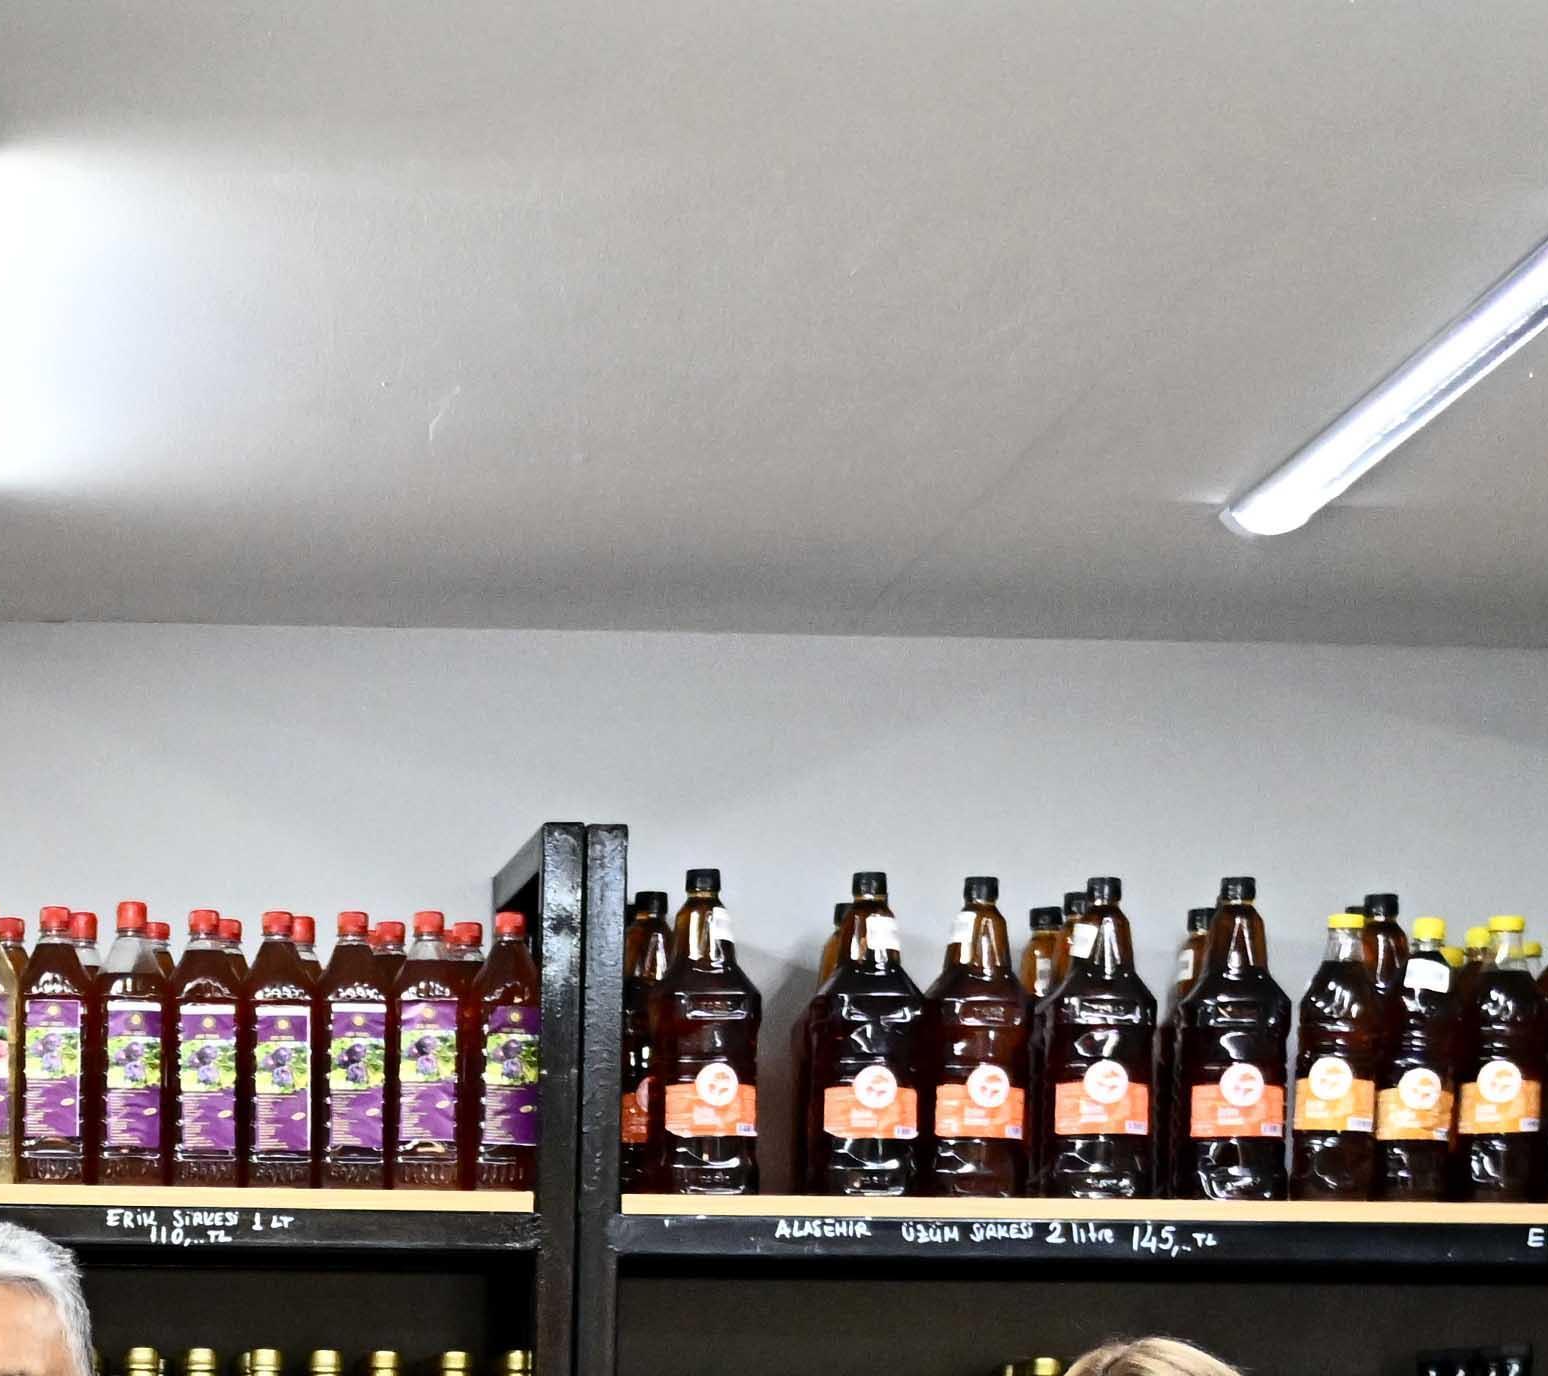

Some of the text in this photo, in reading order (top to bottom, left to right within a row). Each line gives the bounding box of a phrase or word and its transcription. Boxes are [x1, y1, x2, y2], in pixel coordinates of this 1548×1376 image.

[252, 1211, 264, 1232] 1
[270, 1215, 295, 1229] LT
[1046, 1222, 1066, 1244] 2
